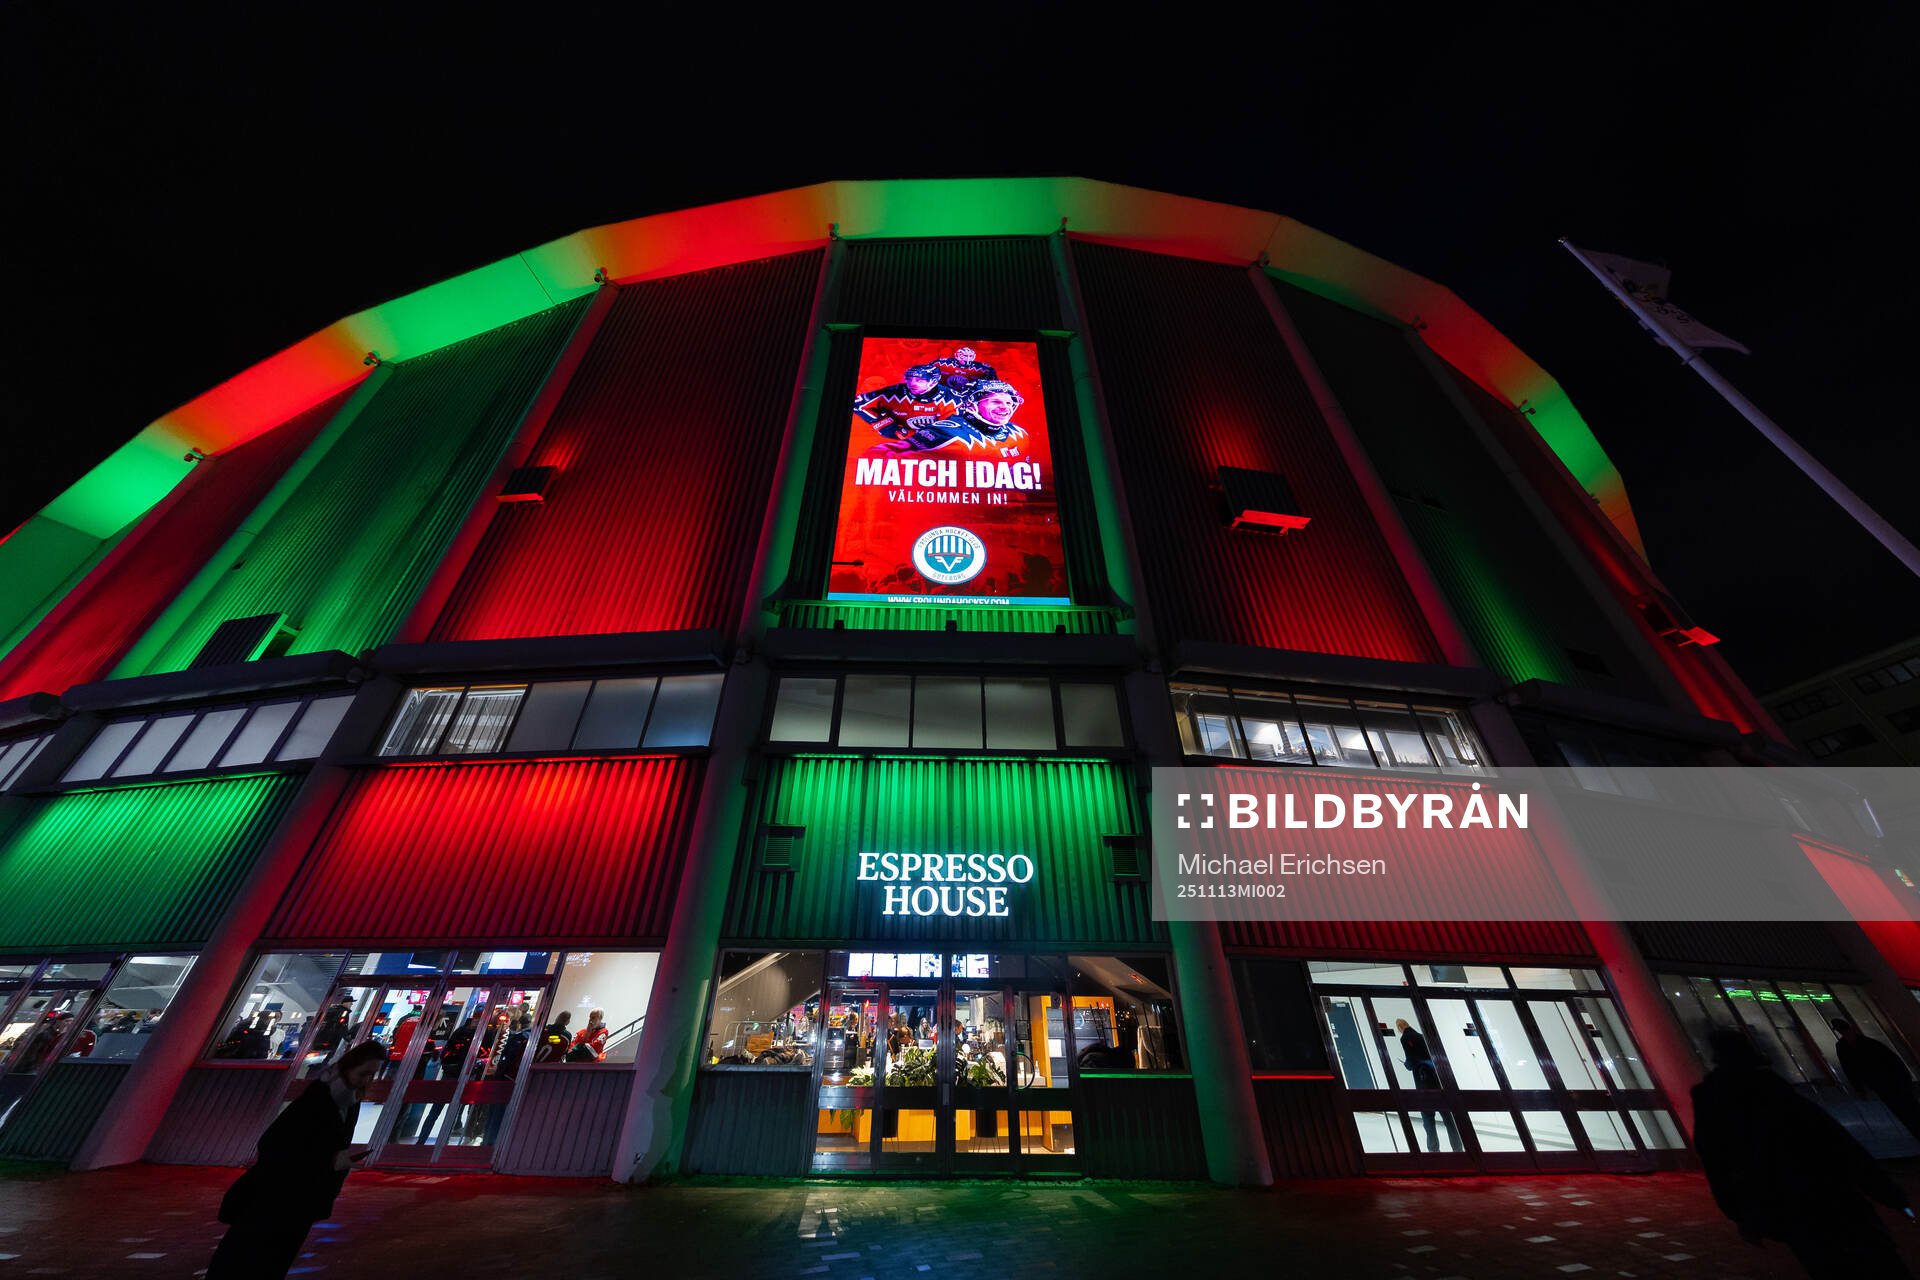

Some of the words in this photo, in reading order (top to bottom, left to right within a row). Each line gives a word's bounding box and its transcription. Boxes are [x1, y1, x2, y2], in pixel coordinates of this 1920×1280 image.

[855, 457, 957, 488] MATCH
[965, 460, 1042, 490] IDAG!
[888, 489, 980, 504] VÄLKOMMEN
[987, 493, 1008, 505] IN!
[857, 852, 1034, 883] ESPRESSO
[882, 885, 1009, 917] HOUSE
